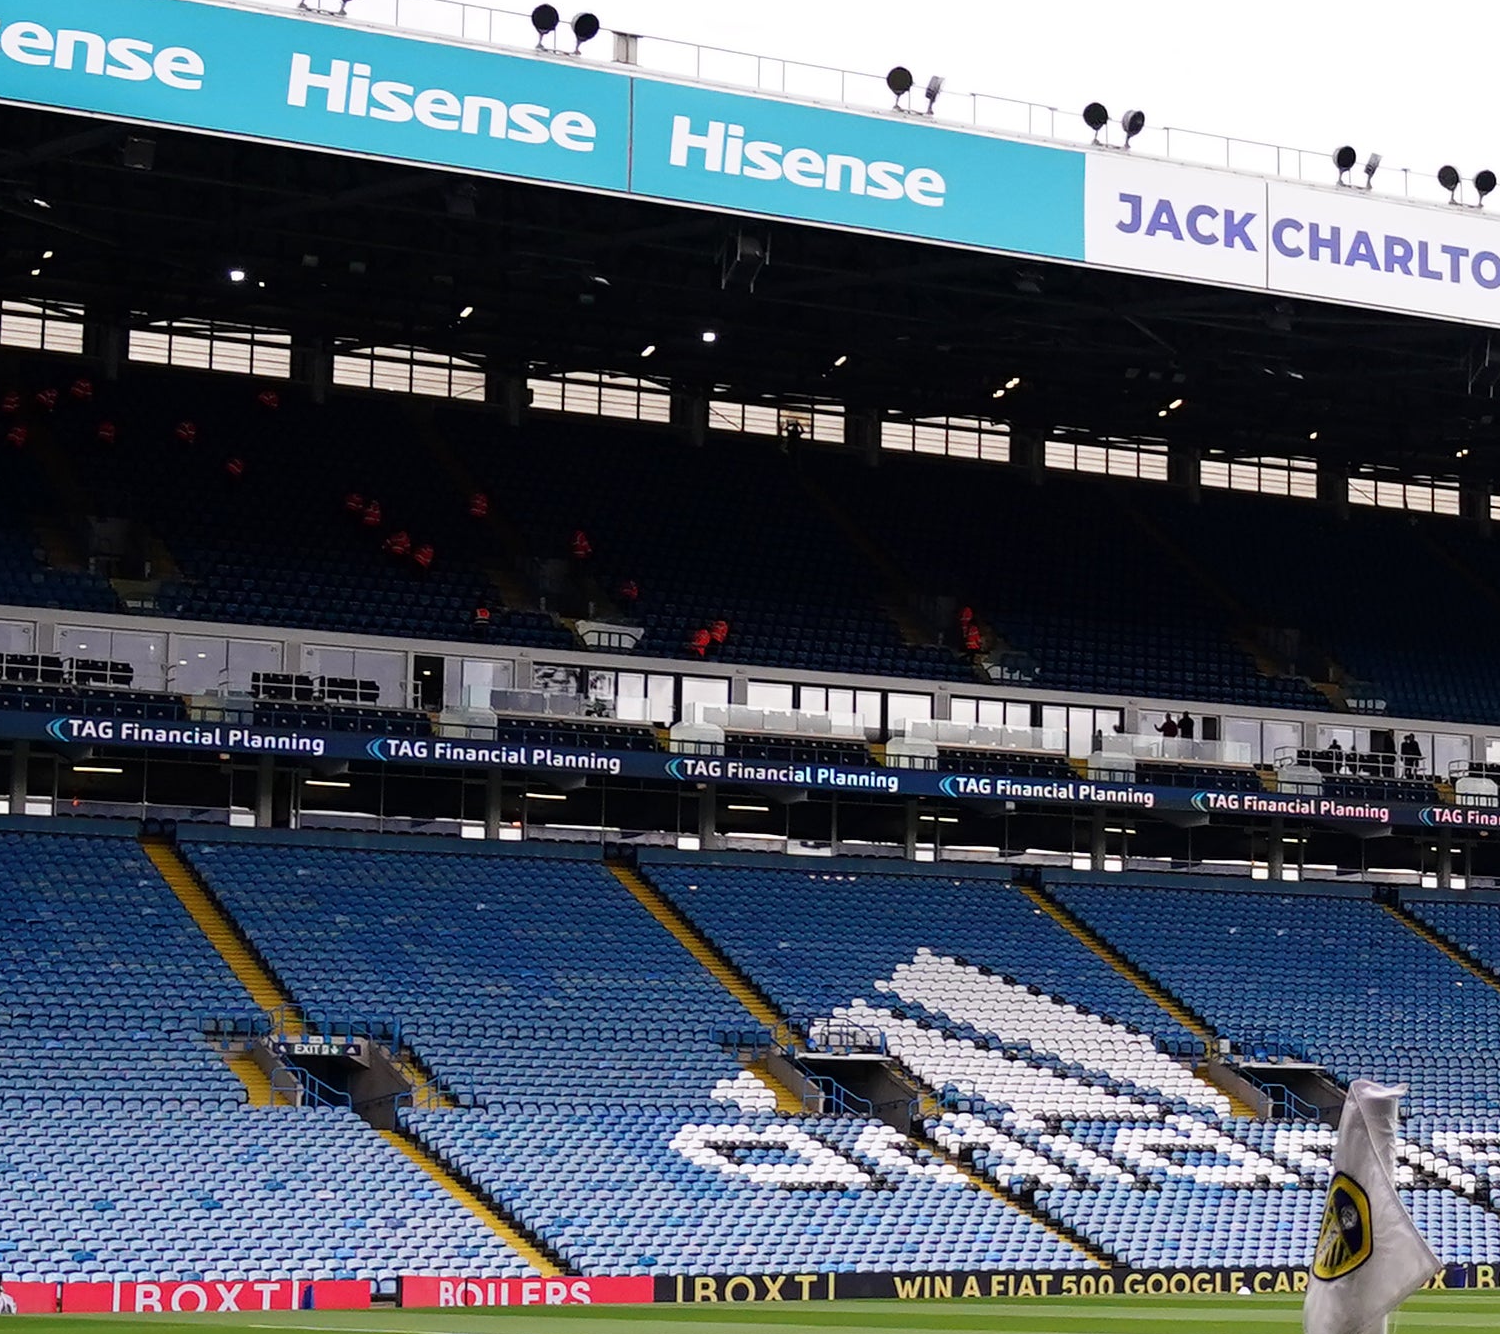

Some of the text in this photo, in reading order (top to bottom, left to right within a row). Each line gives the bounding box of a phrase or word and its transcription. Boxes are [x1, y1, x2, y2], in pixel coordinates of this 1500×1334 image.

[287, 54, 597, 152] Hisense
[670, 117, 947, 207] Hisense
[1115, 193, 1258, 254] JACK
[69, 720, 324, 755] TAG Financial Planning
[387, 740, 620, 774] TAG Financial Planning
[684, 760, 898, 792] TAG Financial Planning
[956, 778, 1153, 807] TAG Financial Planning
[1207, 793, 1388, 822] TAG Financial Planning
[1433, 808, 1462, 823] TAG
[294, 1044, 322, 1055] EXIT
[136, 1282, 280, 1312] BOXT
[694, 1276, 815, 1304] BOXT
[894, 1275, 953, 1299] WIN
[960, 1275, 981, 1298] A
[991, 1275, 1052, 1298] FIAT
[1061, 1274, 1114, 1298] 500
[1253, 1272, 1308, 1295] CAR
